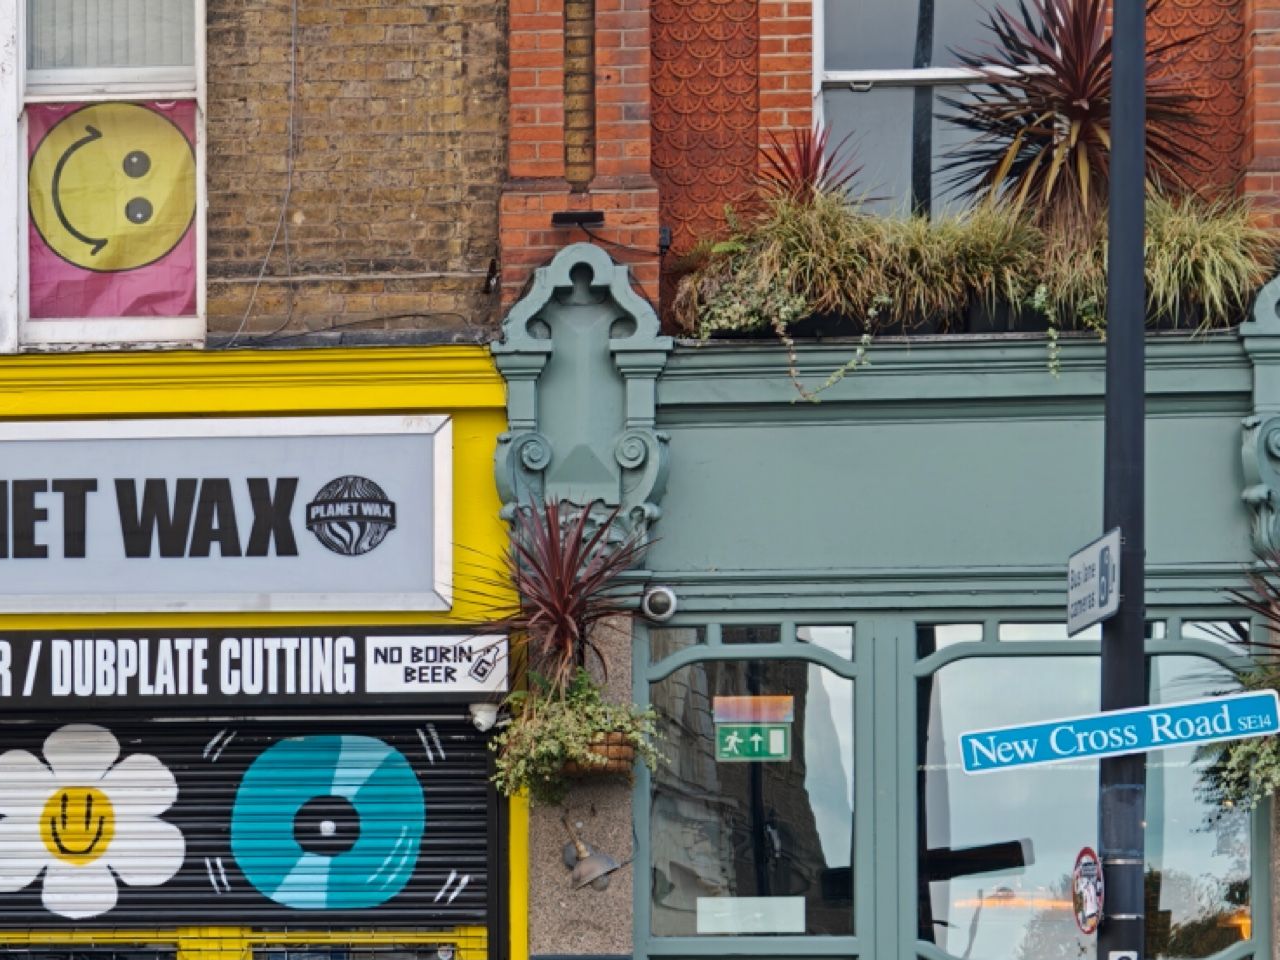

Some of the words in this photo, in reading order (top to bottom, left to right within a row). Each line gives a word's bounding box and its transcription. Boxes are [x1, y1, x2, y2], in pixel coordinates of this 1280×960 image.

[114, 477, 299, 558] WAX
[310, 502, 358, 519] PLANET
[361, 501, 391, 518] WAX
[22, 640, 42, 697] /
[51, 638, 208, 696] DUBPLATE
[220, 636, 356, 695] CUTTING
[373, 646, 403, 665] NO
[403, 665, 458, 684] BEER
[969, 735, 1039, 768] New
[1049, 723, 1138, 756] Cross
[1148, 703, 1233, 743] Road
[1237, 713, 1273, 731] SE14
